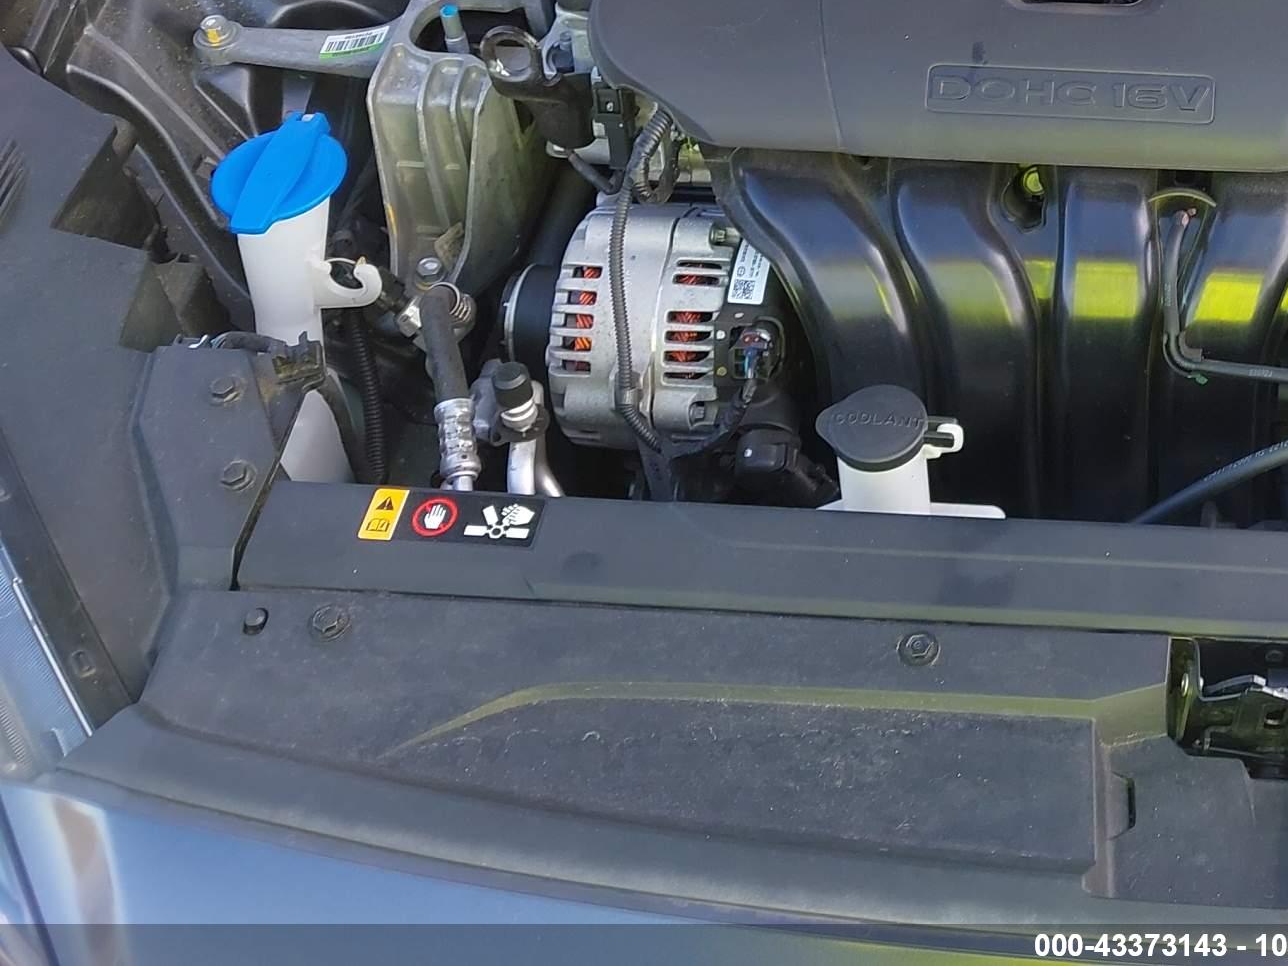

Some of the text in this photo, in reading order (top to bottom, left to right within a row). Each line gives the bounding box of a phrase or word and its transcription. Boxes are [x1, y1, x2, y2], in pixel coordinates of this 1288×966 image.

[929, 75, 1211, 112] DOHC 16V
[834, 412, 924, 430] COOLANT
